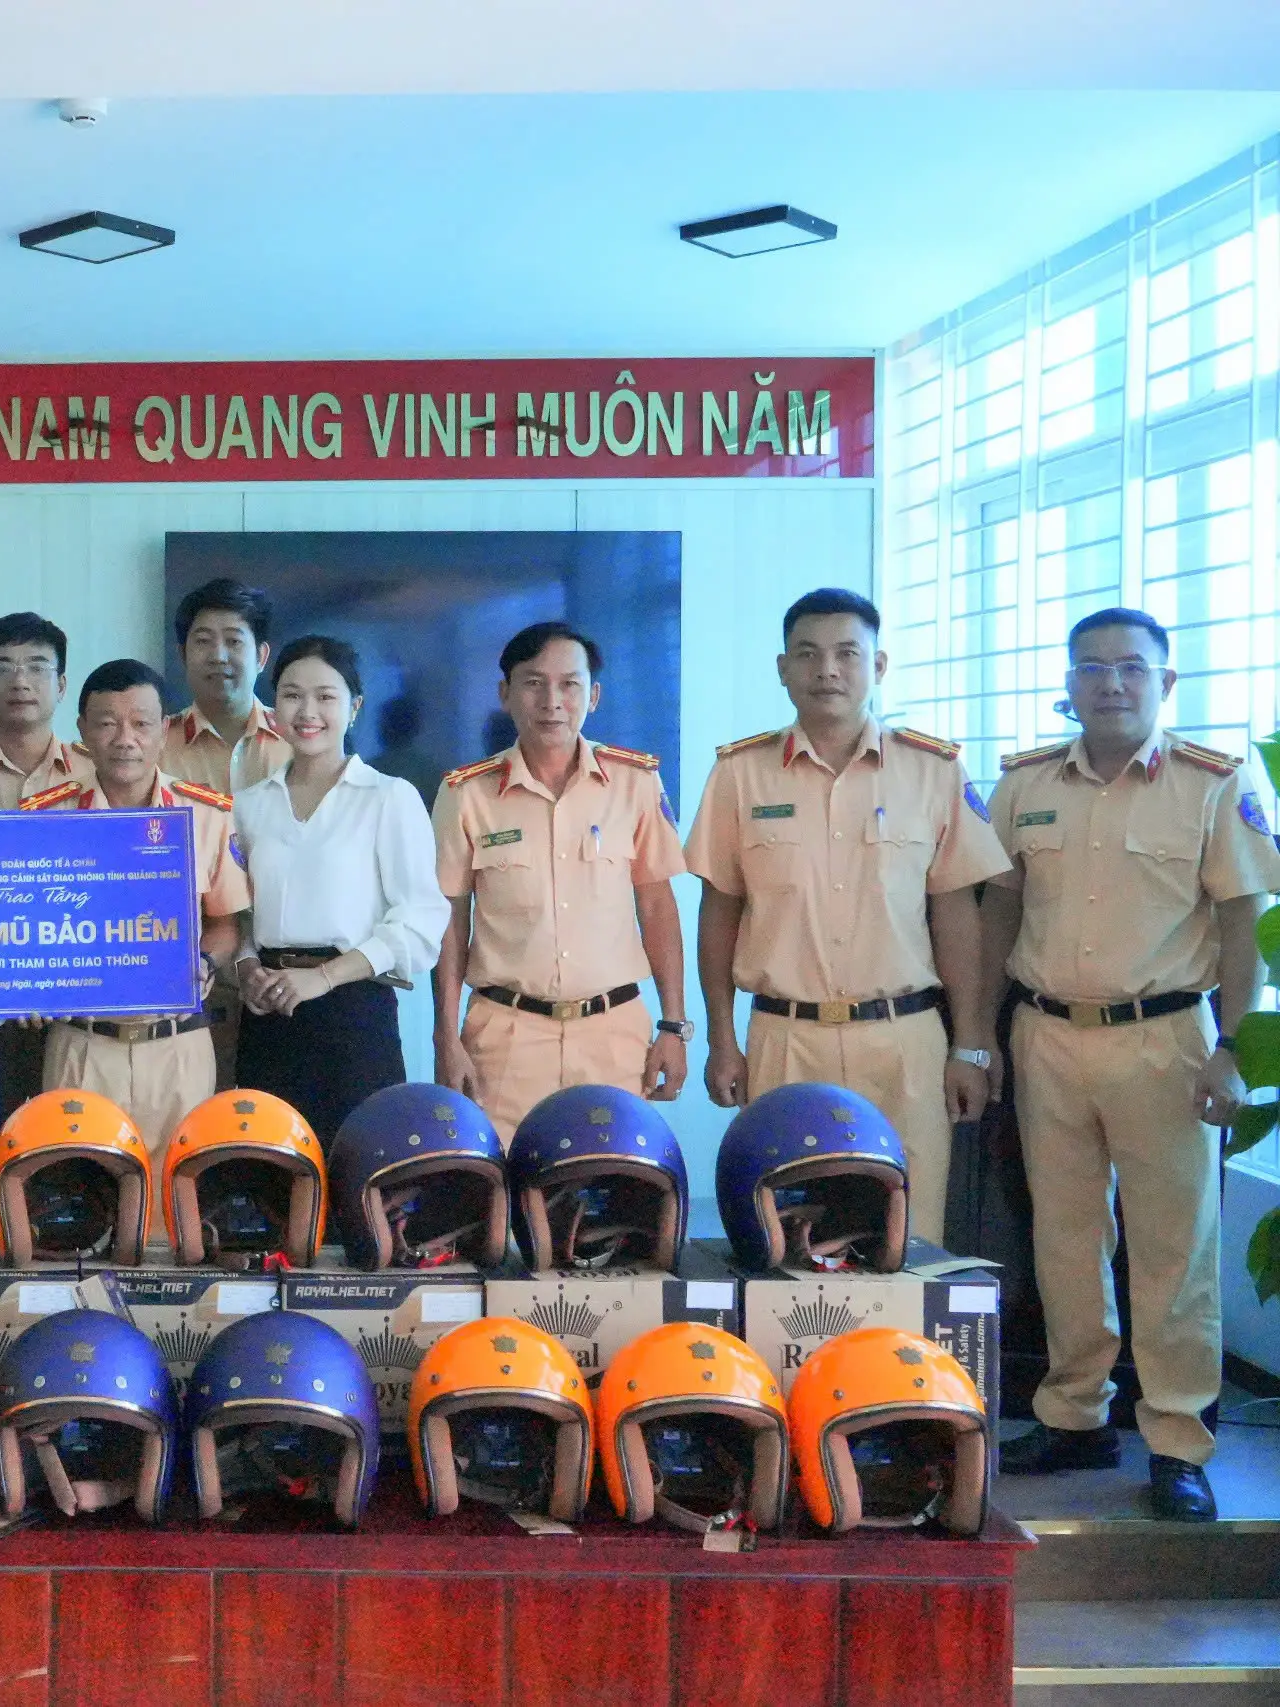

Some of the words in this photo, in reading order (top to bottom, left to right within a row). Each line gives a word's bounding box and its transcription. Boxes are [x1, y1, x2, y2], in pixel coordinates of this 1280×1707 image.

[133, 391, 344, 465] QUANG
[362, 391, 498, 458] VINH
[517, 370, 684, 458] MUÔN
[702, 370, 832, 457] NĂM
[27, 857, 52, 869] QUỐC
[11, 872, 35, 883] CẢNH
[36, 872, 52, 882] SÁT
[53, 873, 75, 882] GIAO
[76, 871, 105, 881] THÔNG
[42, 886, 93, 910] Tặng
[37, 913, 97, 945] BẢO
[104, 911, 179, 943] HIỂM
[9, 958, 45, 969] THAM
[48, 957, 70, 968] GIA
[72, 957, 102, 968] GIAO
[106, 953, 149, 967] THÔNG
[295, 1285, 397, 1298] ROYALHELMET
[958, 1323, 972, 1353] Safety
